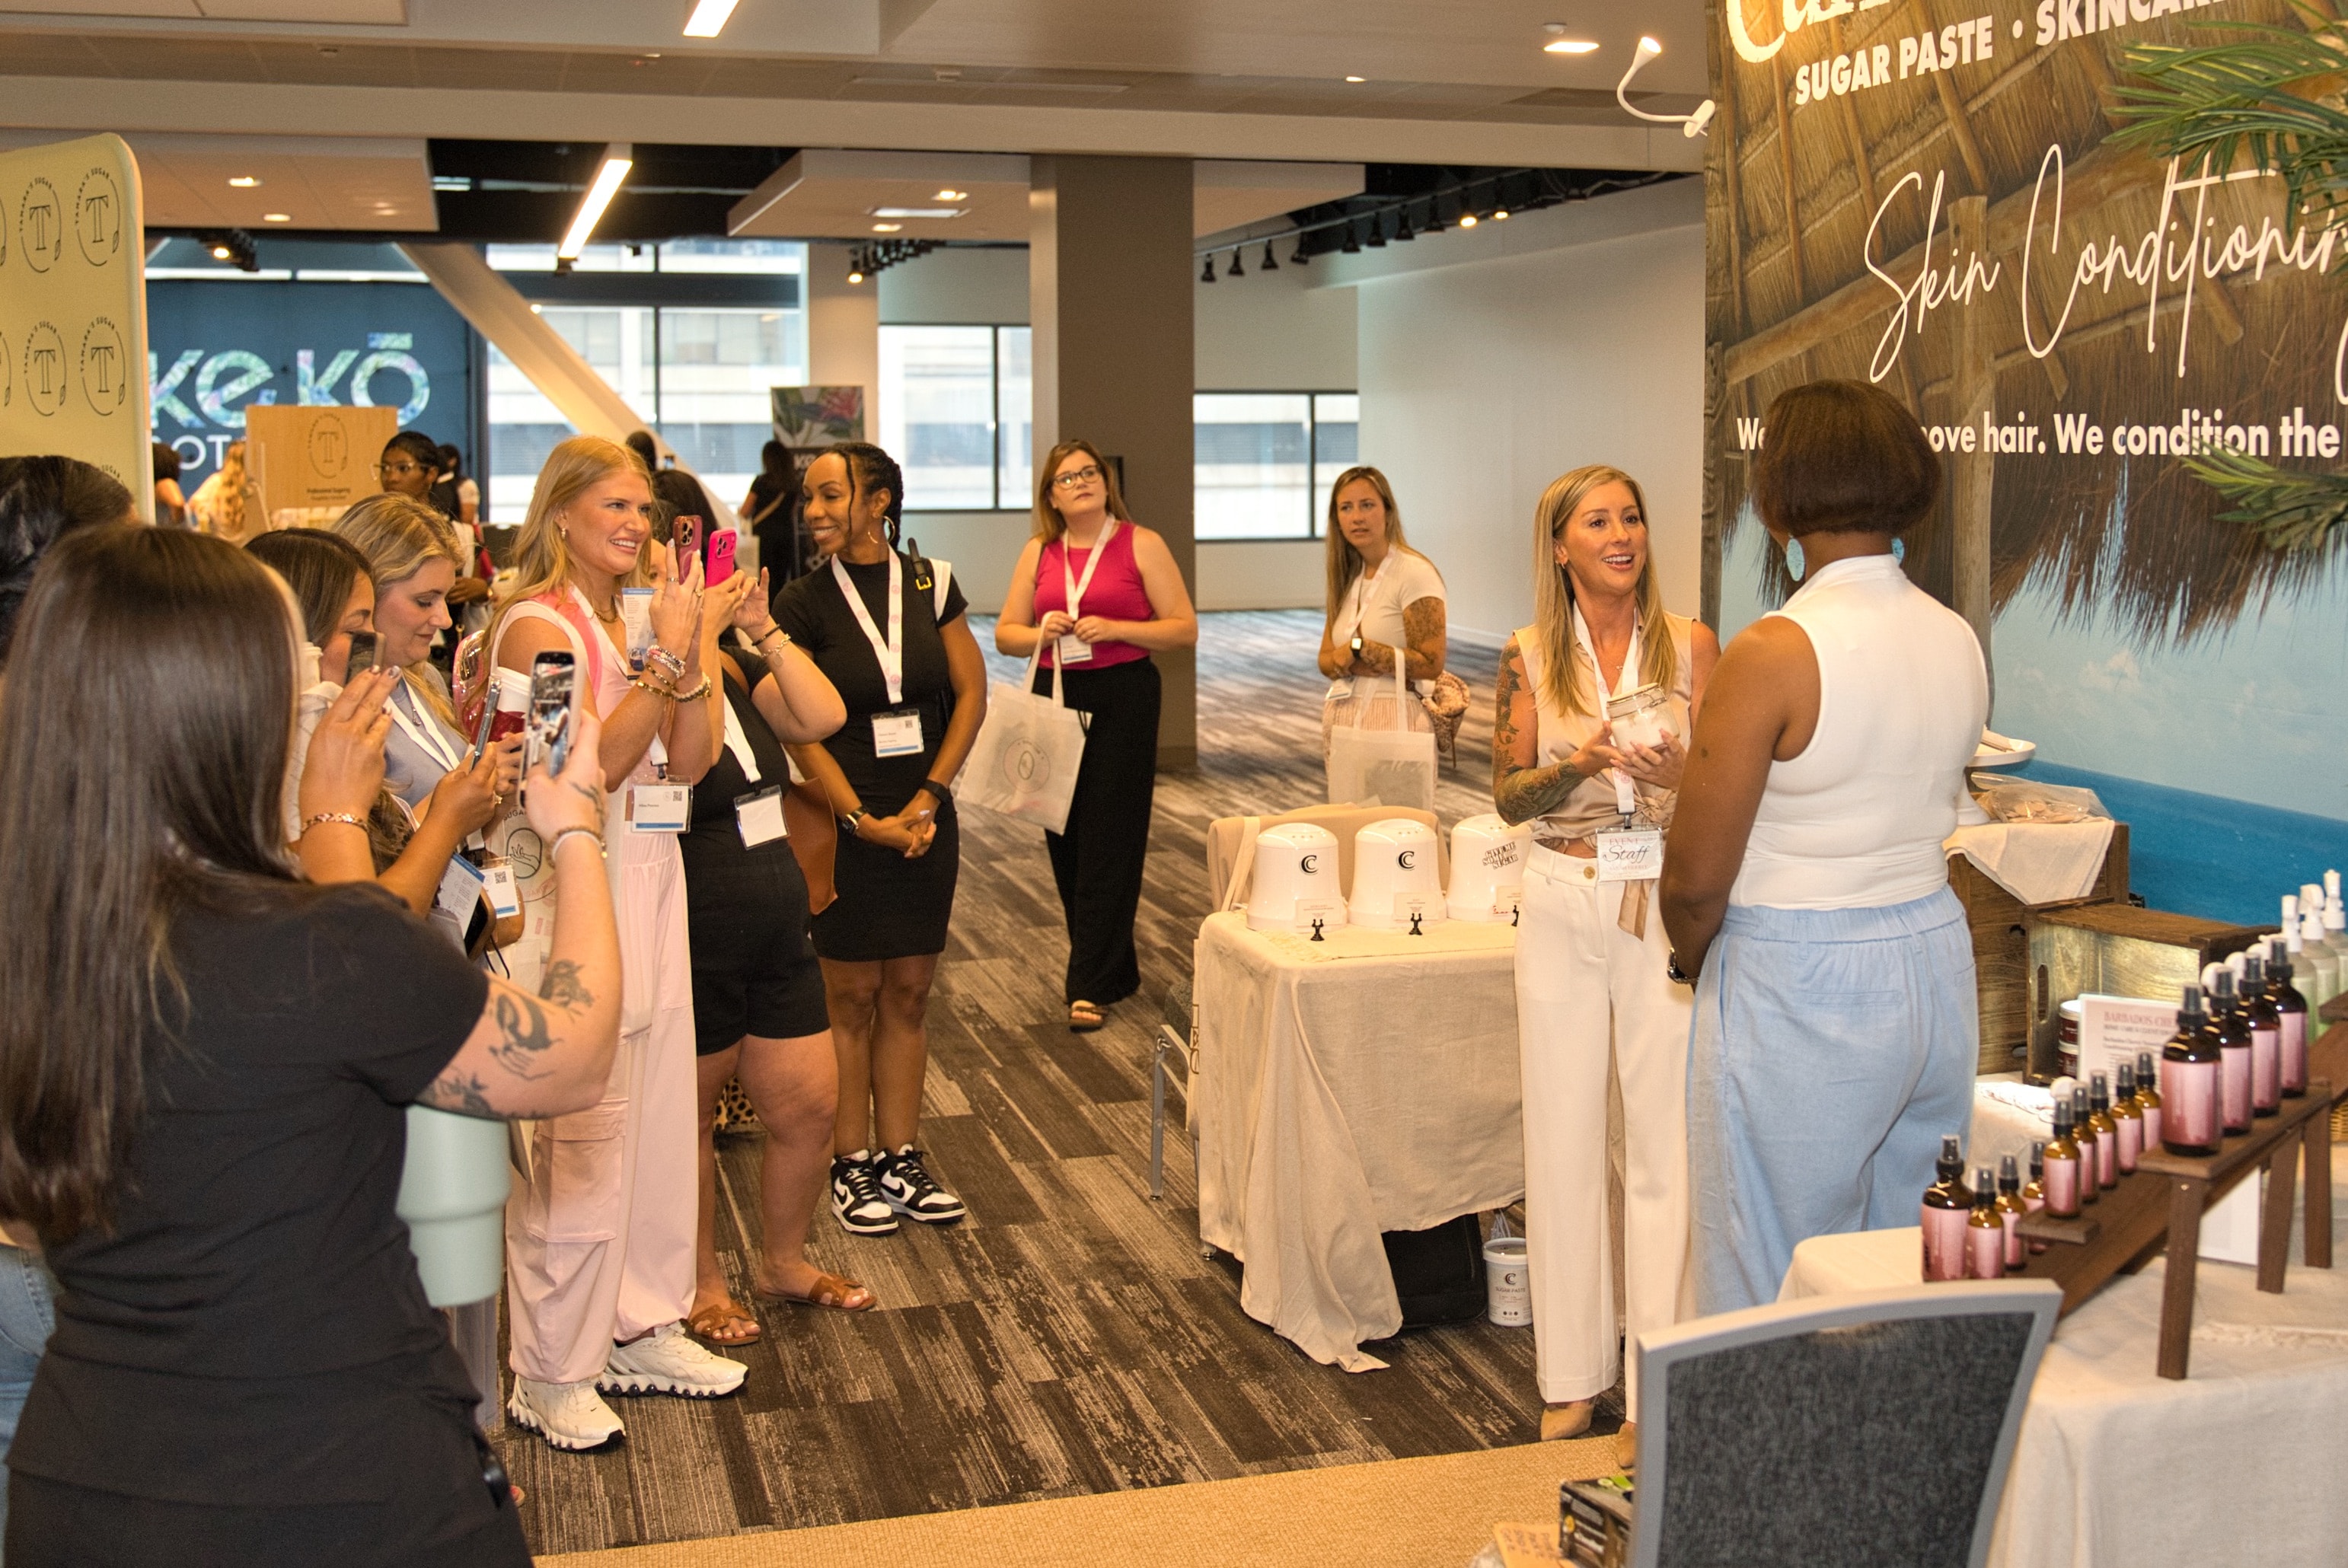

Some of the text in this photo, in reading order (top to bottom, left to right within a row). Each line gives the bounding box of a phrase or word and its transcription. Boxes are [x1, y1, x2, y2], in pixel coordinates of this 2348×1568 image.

[1795, 44, 1891, 105] SUGAR
[1899, 15, 1992, 80] PASTE
[29, 204, 51, 251] T
[85, 194, 109, 244] T
[1865, 143, 2348, 404] Skin Conditionin
[34, 348, 56, 394] T
[91, 346, 114, 394] T
[1983, 411, 2046, 454] hair.
[2053, 413, 2104, 455] We
[2112, 408, 2270, 457] condition
[2279, 407, 2340, 458] the
[1603, 845, 1651, 864] Staff
